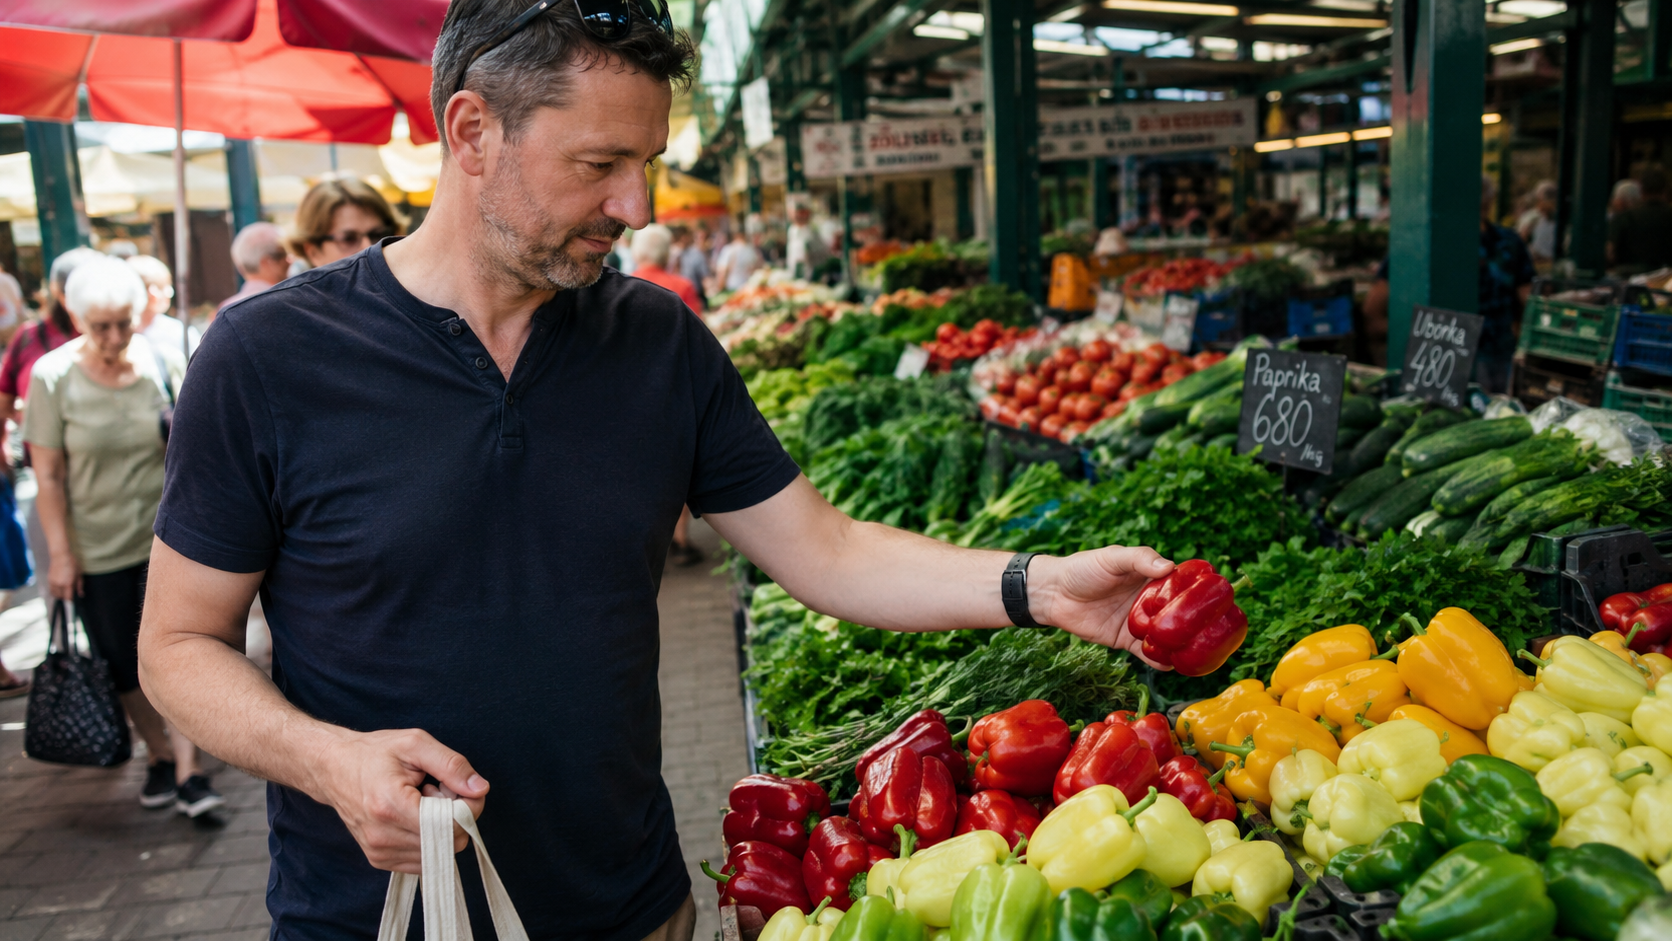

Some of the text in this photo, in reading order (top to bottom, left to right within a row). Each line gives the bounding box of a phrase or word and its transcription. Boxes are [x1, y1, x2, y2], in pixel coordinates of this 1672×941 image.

[1253, 353, 1321, 401] Paprika
[1410, 341, 1455, 388] 480
[1252, 393, 1313, 447] 680
